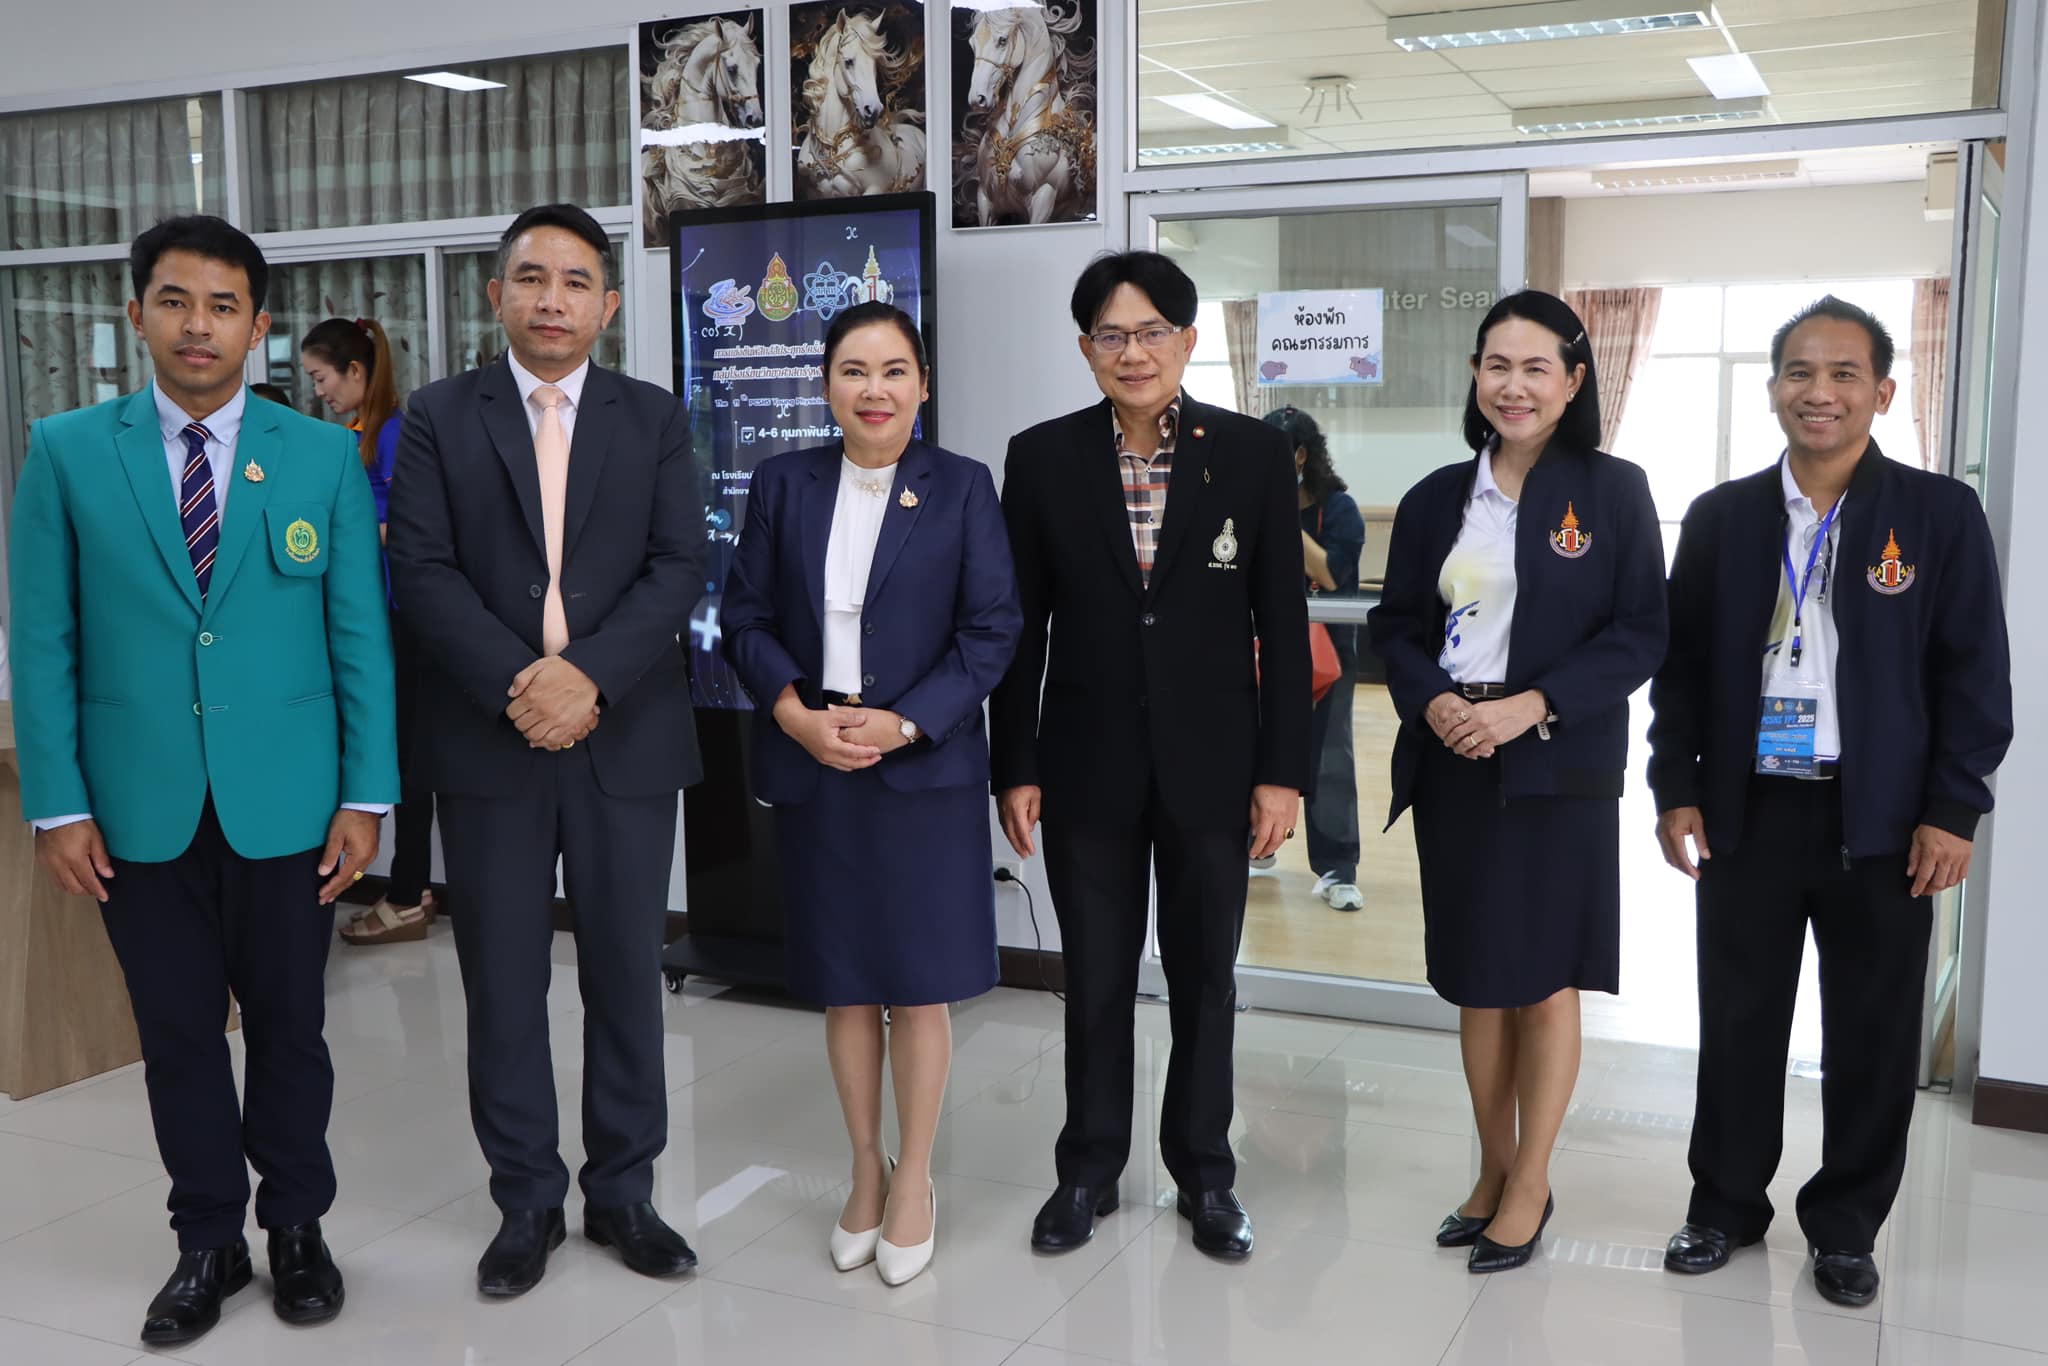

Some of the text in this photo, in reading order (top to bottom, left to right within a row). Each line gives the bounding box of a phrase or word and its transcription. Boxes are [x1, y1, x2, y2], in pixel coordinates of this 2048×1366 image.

[1294, 306, 1346, 326] ห้องพัก
[701, 327, 719, 338] cos
[1271, 335, 1369, 352] คณะกรรมการ
[758, 428, 778, 438] 4-6
[781, 425, 831, 441] กุมภาพันธ์
[1798, 714, 1815, 723] 2025
